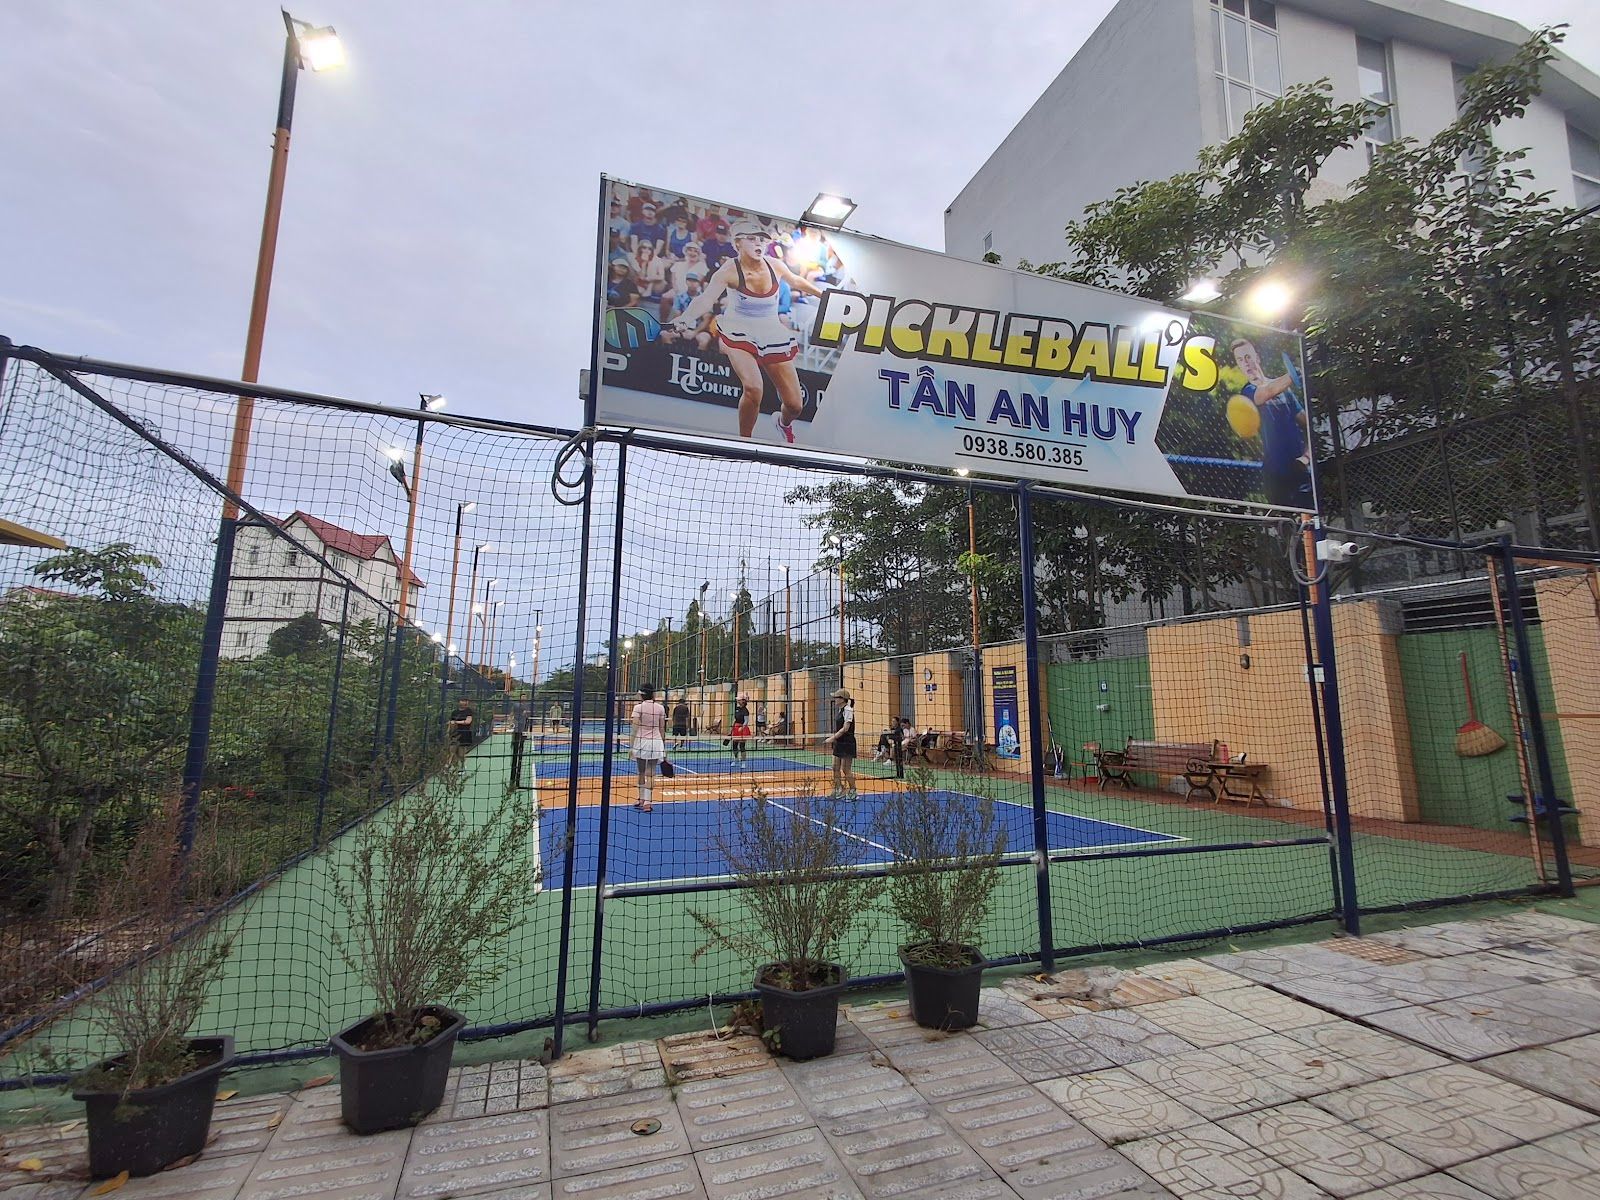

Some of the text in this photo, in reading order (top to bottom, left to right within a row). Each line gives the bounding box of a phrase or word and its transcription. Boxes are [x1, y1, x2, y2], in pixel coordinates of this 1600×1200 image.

[810, 288, 1219, 393] PICKLEBALL'S
[668, 353, 730, 387] HOLM
[680, 373, 741, 398] COURT
[879, 366, 976, 421] TÂN
[987, 388, 1050, 432] AN
[1062, 399, 1143, 445] HUY
[963, 434, 1083, 466] 0938.580.385
